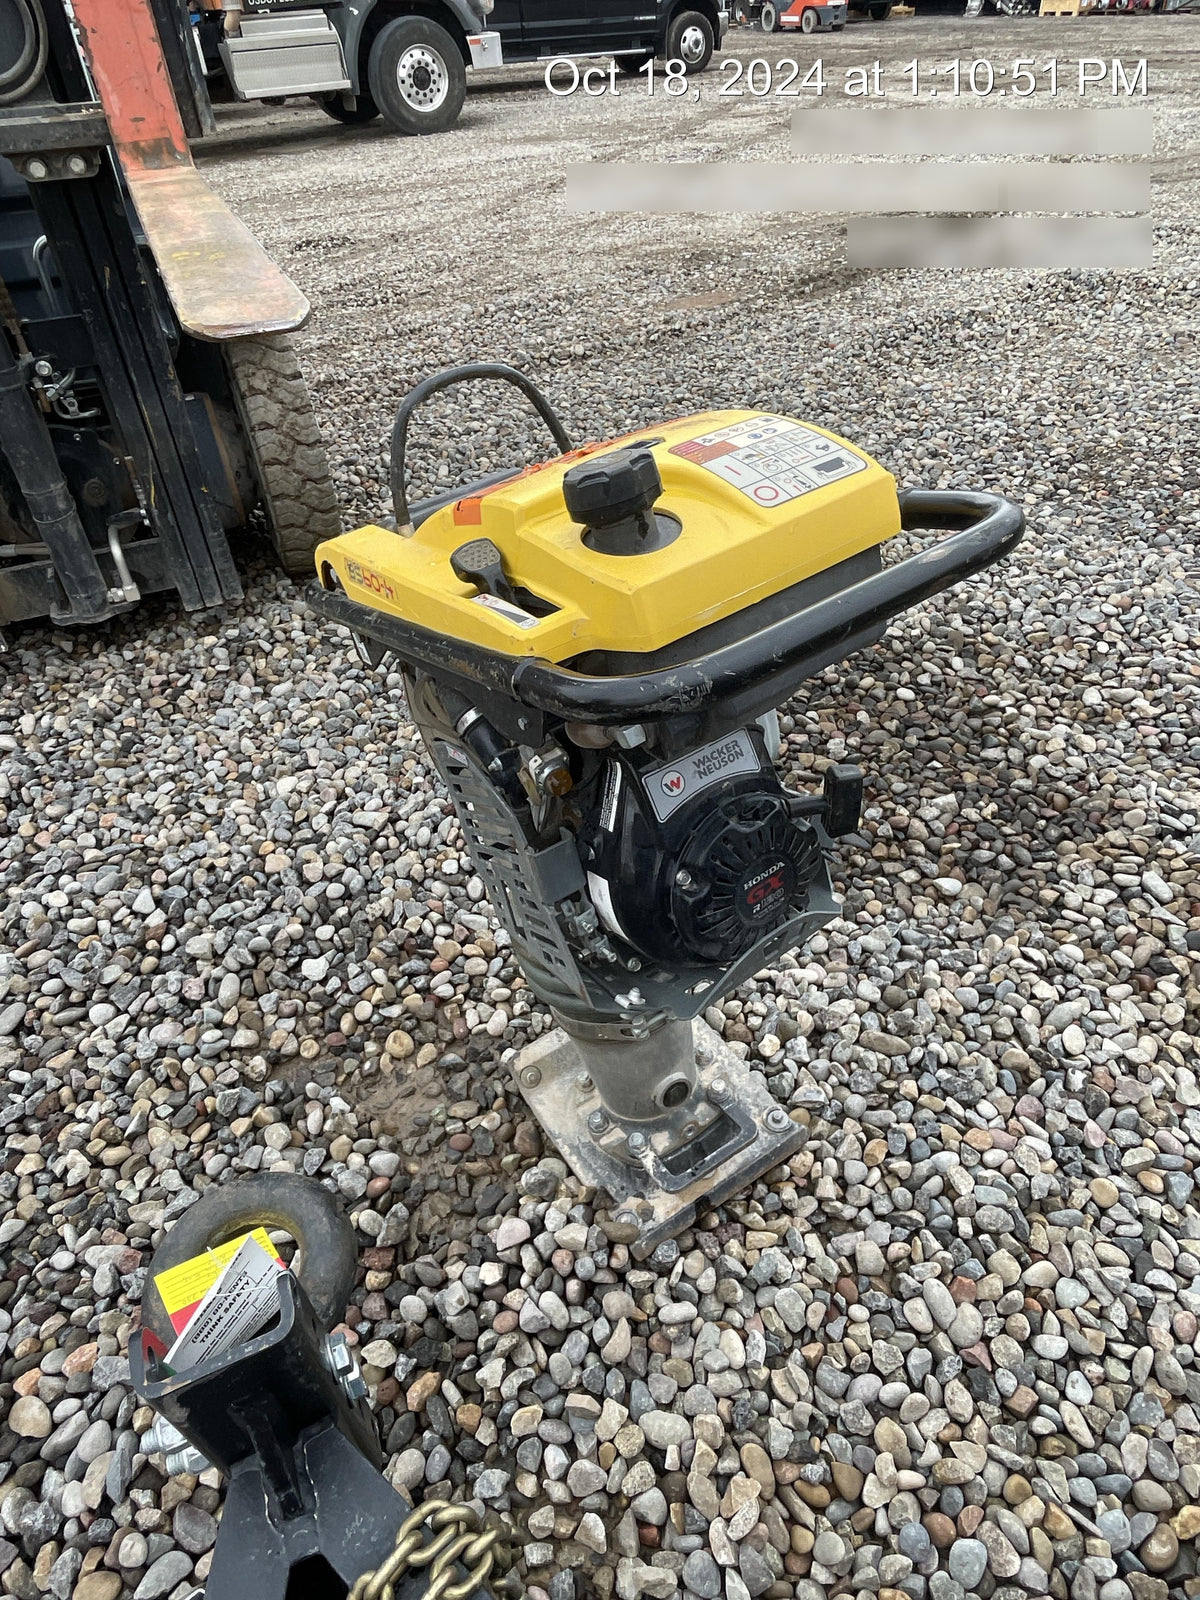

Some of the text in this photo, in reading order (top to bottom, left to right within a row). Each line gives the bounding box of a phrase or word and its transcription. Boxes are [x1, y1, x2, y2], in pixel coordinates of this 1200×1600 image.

[692, 740, 740, 769] WACKER
[696, 748, 745, 780] NEUSON
[743, 861, 786, 891] HONDA
[746, 869, 785, 905] GX
[200, 1314, 224, 1344] THINK
[223, 1279, 250, 1314] SAFETY
